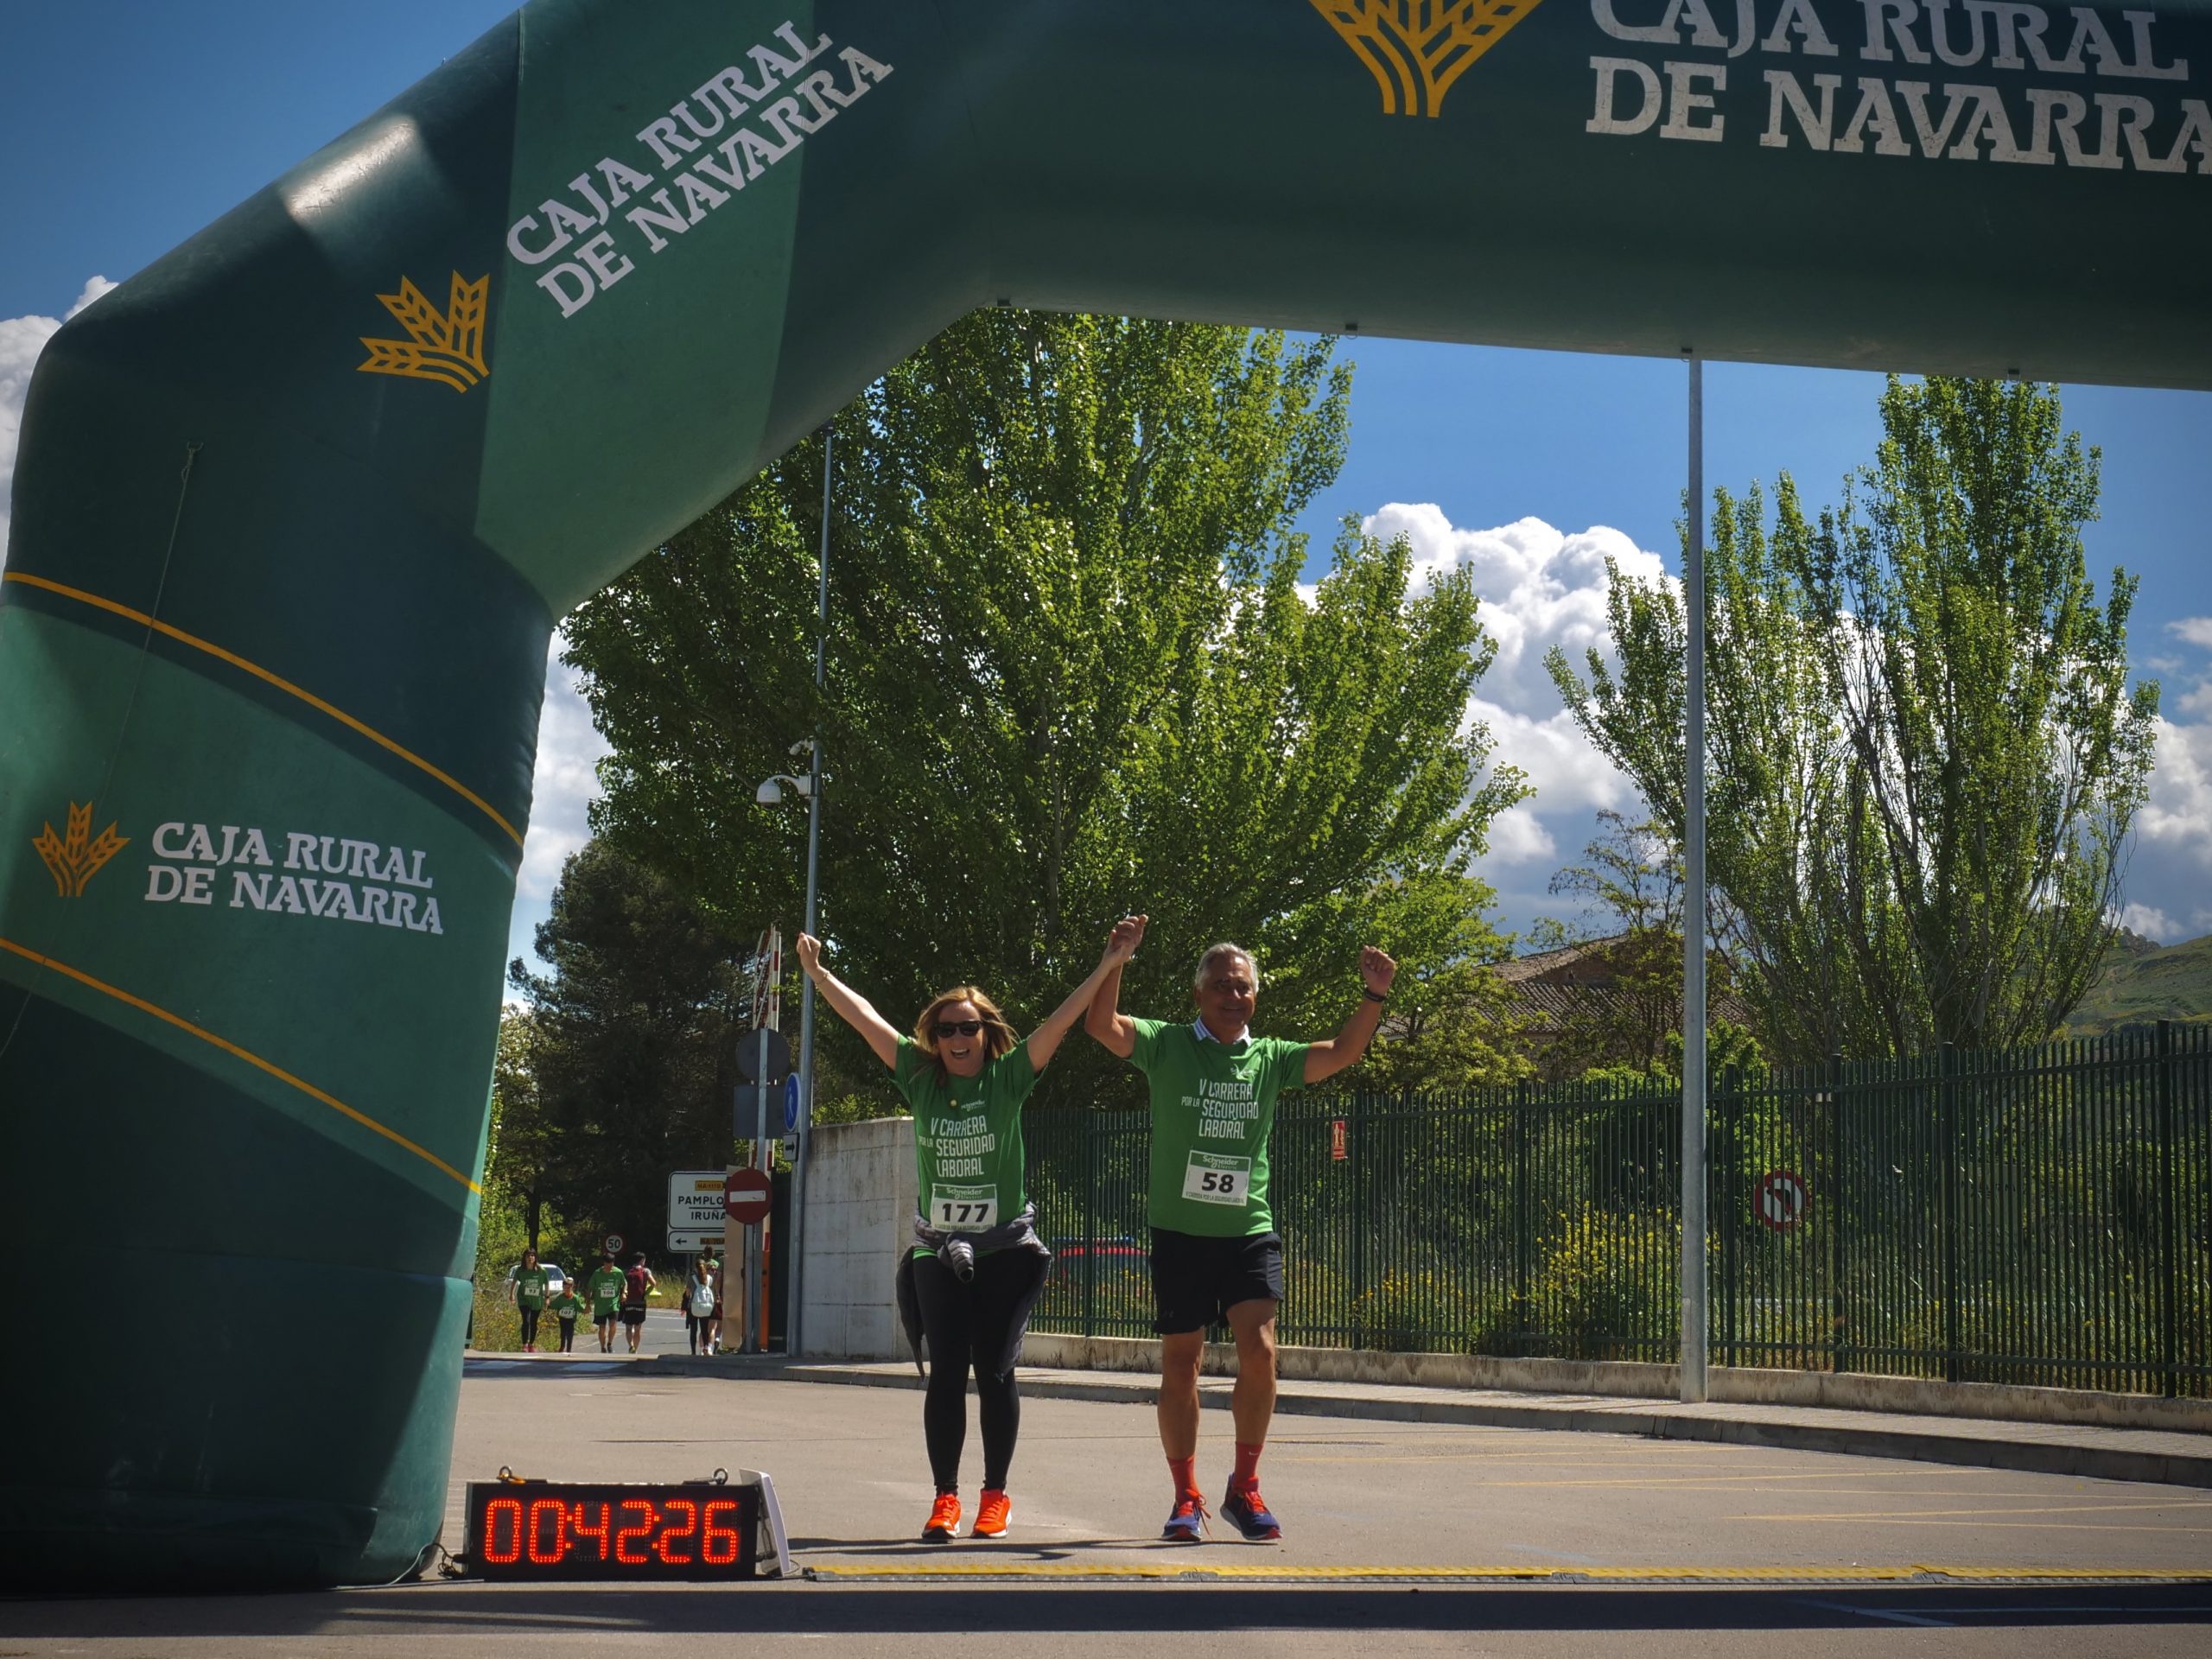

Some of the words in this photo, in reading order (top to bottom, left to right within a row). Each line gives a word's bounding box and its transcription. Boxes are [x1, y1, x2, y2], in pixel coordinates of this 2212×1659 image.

[1591, 0, 1839, 58] CAJA
[1859, 0, 2189, 80] RURAL
[1586, 55, 1726, 142] DE
[1759, 69, 2212, 175] NAVARRA
[506, 156, 655, 264] CAJA
[635, 20, 833, 170] RURAL
[536, 230, 635, 318] DE
[625, 46, 894, 253] NAVARRA
[152, 822, 272, 866] CAJA
[283, 832, 433, 888] RURAL
[144, 865, 215, 905] DE
[230, 871, 444, 934] NAVARRA
[1198, 1078, 1207, 1096] V
[1181, 1096, 1192, 1107] POR
[1192, 1097, 1200, 1107] LA
[1201, 1098, 1258, 1120] SEGURIDAD
[931, 1117, 938, 1135] V
[939, 1115, 988, 1137] CARRERA
[1198, 1119, 1245, 1140] LABORAL
[927, 1137, 933, 1147] LA
[936, 1133, 995, 1157] SEGURIDAD
[936, 1157, 984, 1178] LABORAL
[1202, 1154, 1239, 1166] Schneider
[946, 1187, 983, 1197] Schneider
[1201, 1172, 1235, 1193] 58
[678, 1196, 724, 1205] PAMPLO
[691, 1210, 726, 1220] IRUÑA
[942, 1203, 988, 1223] 177
[607, 1238, 621, 1249] 50
[485, 1499, 738, 1564] 00:42:26
